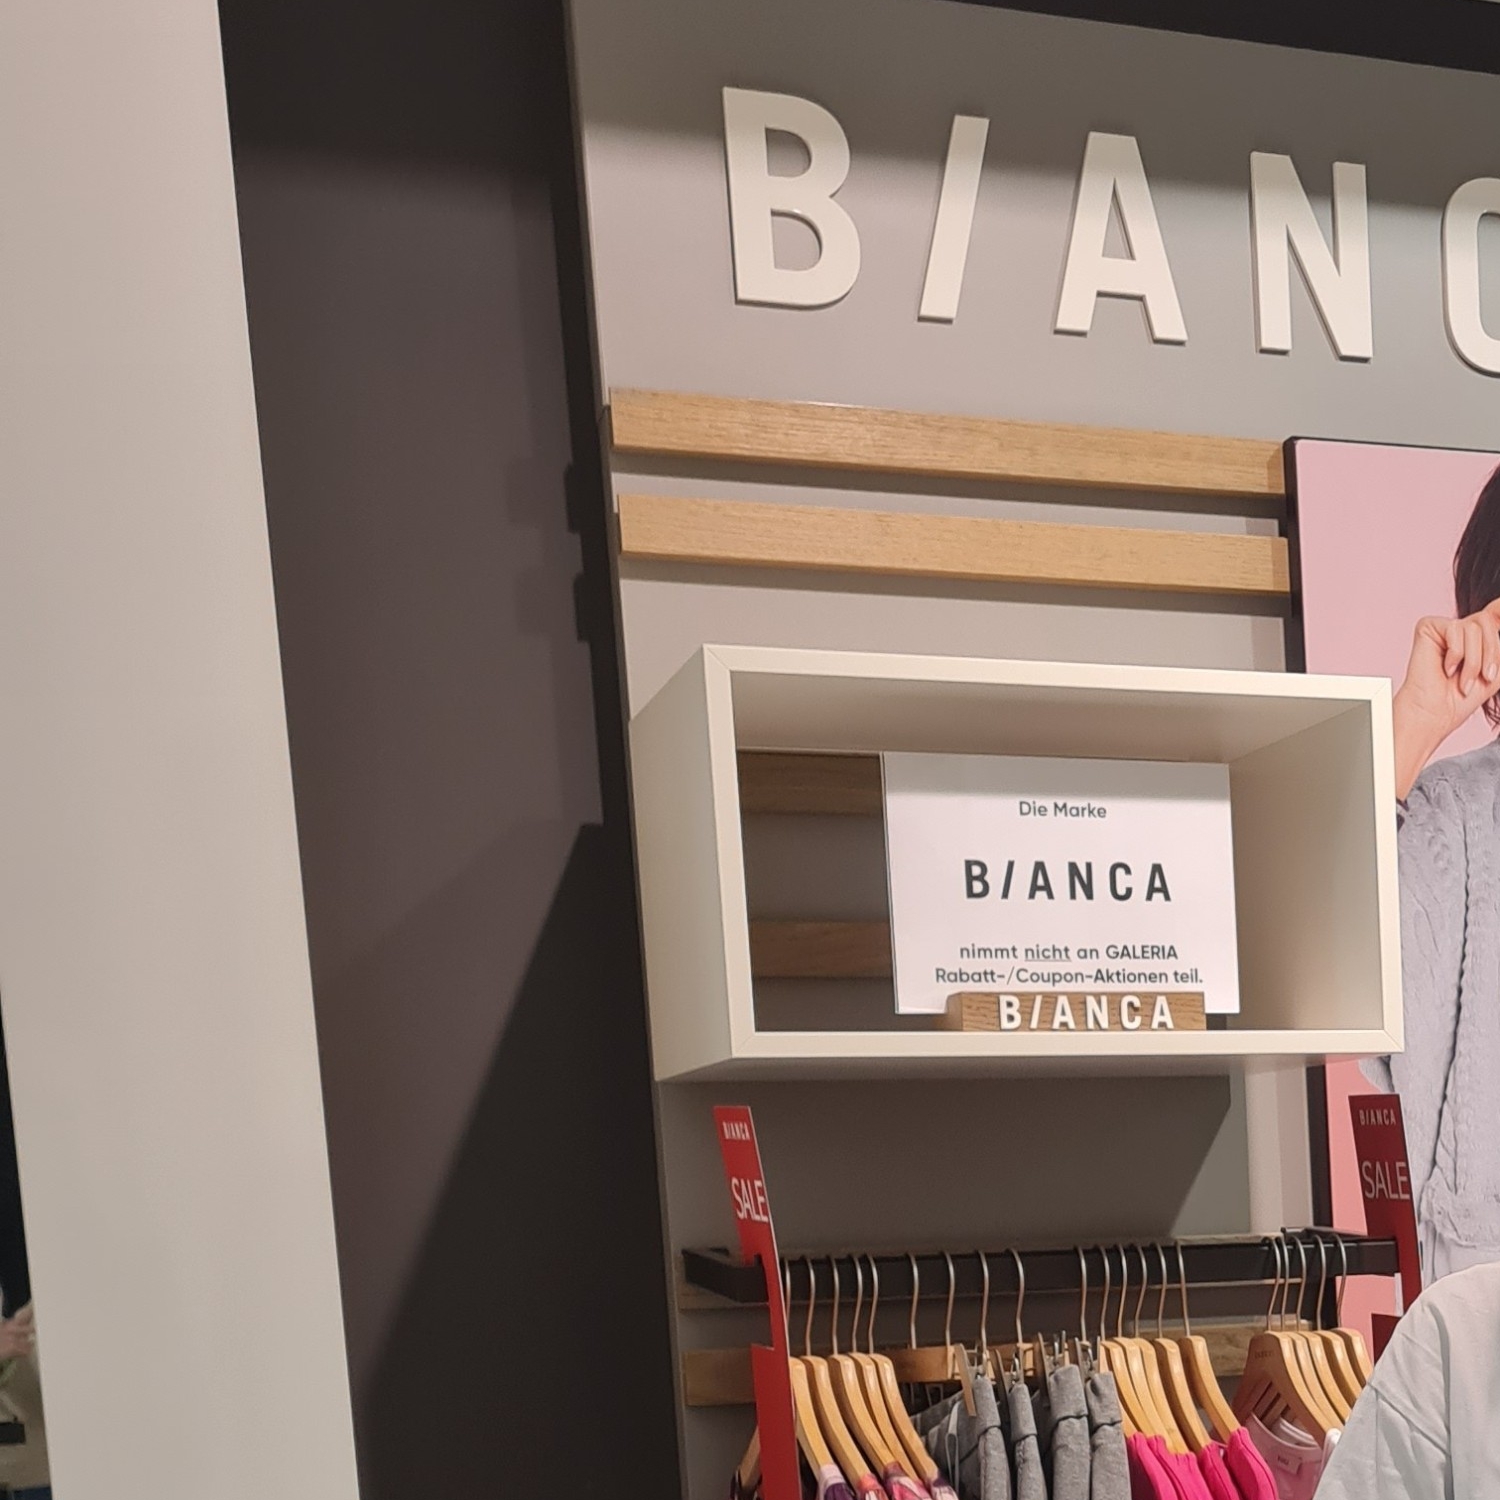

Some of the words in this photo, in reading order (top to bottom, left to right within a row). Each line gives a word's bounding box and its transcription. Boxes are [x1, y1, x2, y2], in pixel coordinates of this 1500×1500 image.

[1019, 801, 1048, 817] Die
[1053, 802, 1107, 819] Marke
[959, 944, 1017, 960] nimmt
[1024, 944, 1071, 961] nicht
[1076, 947, 1100, 960] an
[1105, 944, 1178, 960] GALERIA
[1172, 967, 1204, 984] teil.
[1361, 1160, 1410, 1199] SALE
[731, 1177, 769, 1222] SALE
